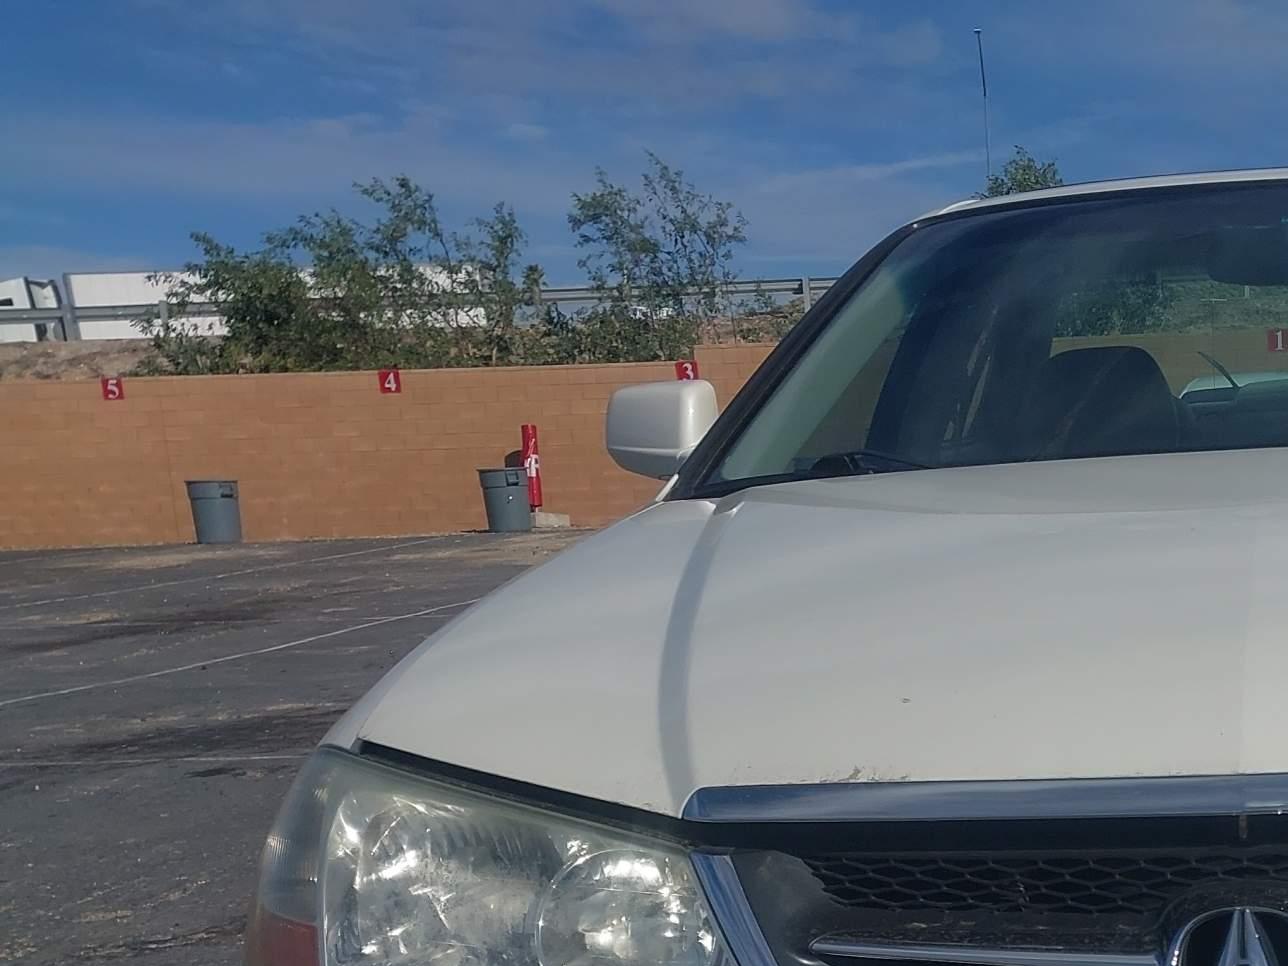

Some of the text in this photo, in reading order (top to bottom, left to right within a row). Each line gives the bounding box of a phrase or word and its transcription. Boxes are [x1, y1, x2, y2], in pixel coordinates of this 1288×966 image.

[1275, 330, 1285, 351] 1
[384, 372, 397, 392] 4
[682, 363, 694, 381] 3
[107, 379, 119, 399] 5
